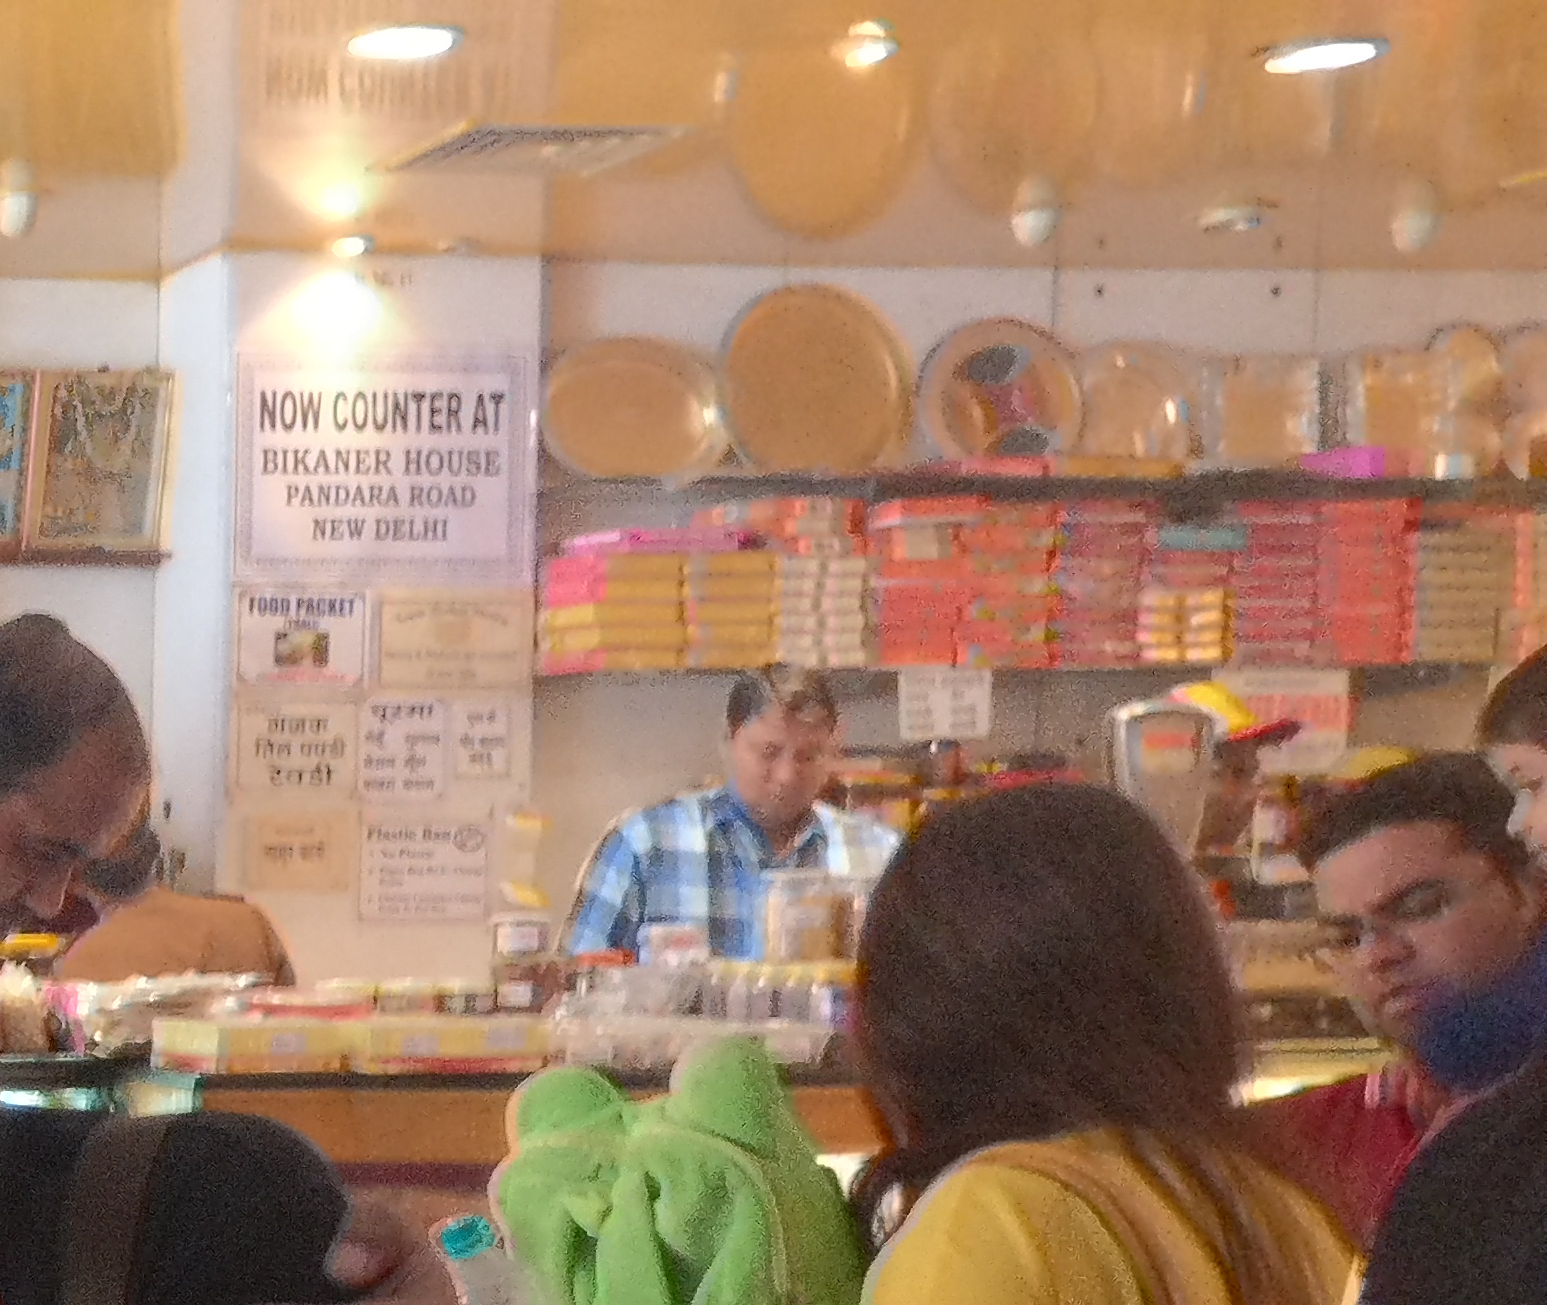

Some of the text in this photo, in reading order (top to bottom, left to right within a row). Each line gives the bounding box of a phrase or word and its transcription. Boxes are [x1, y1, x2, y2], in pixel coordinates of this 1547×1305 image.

[259, 390, 506, 435] NOW COUNTER AT
[262, 446, 501, 478] BIKANER HOUSE
[285, 483, 477, 508] PANDARA ROAD
[311, 517, 449, 542] NEW DELHI
[248, 595, 356, 618] FOOD PACKET
